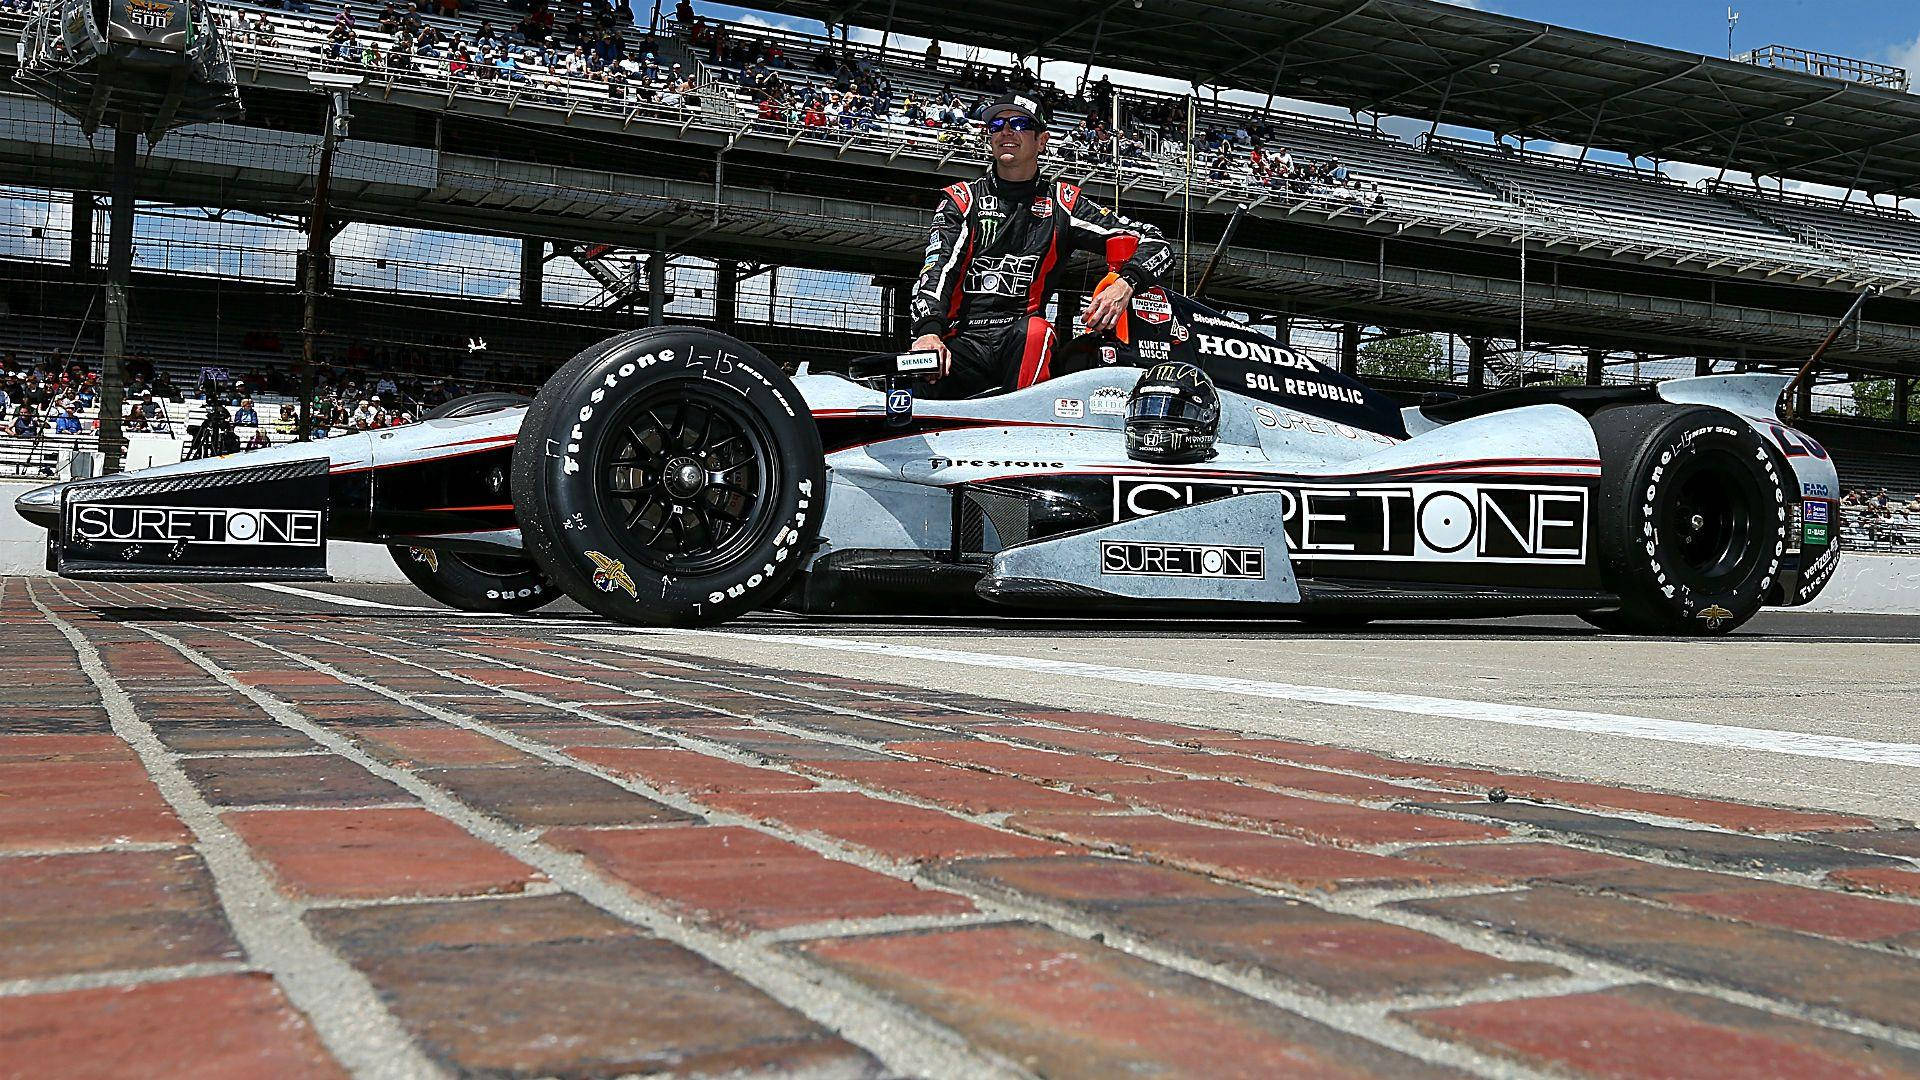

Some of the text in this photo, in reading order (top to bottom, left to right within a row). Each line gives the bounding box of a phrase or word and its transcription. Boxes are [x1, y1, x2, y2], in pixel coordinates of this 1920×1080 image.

[132, 13, 166, 28] 500
[965, 273, 1031, 296] TONE
[1136, 300, 1168, 309] INDYCAR
[685, 345, 739, 374] L-15
[1138, 340, 1159, 350] KURT
[1140, 349, 1168, 360] BUSCH
[1197, 333, 1319, 373] HONDA
[901, 358, 933, 366] SIEMENS
[736, 362, 796, 417] INDY 500
[892, 394, 911, 410] ZF
[1246, 372, 1364, 405] SOL REPUBLIC
[563, 349, 675, 476] Firestone
[1715, 426, 1738, 436] 500
[928, 458, 1064, 470] Firestone
[1803, 482, 1829, 497] FARO
[77, 507, 319, 543] SURETONE
[1643, 450, 1676, 598] Firestone
[1756, 447, 1786, 590] Firestone
[709, 478, 812, 604] Firestone
[1104, 546, 1263, 577] SURETONE
[1804, 550, 1832, 580] verizon
